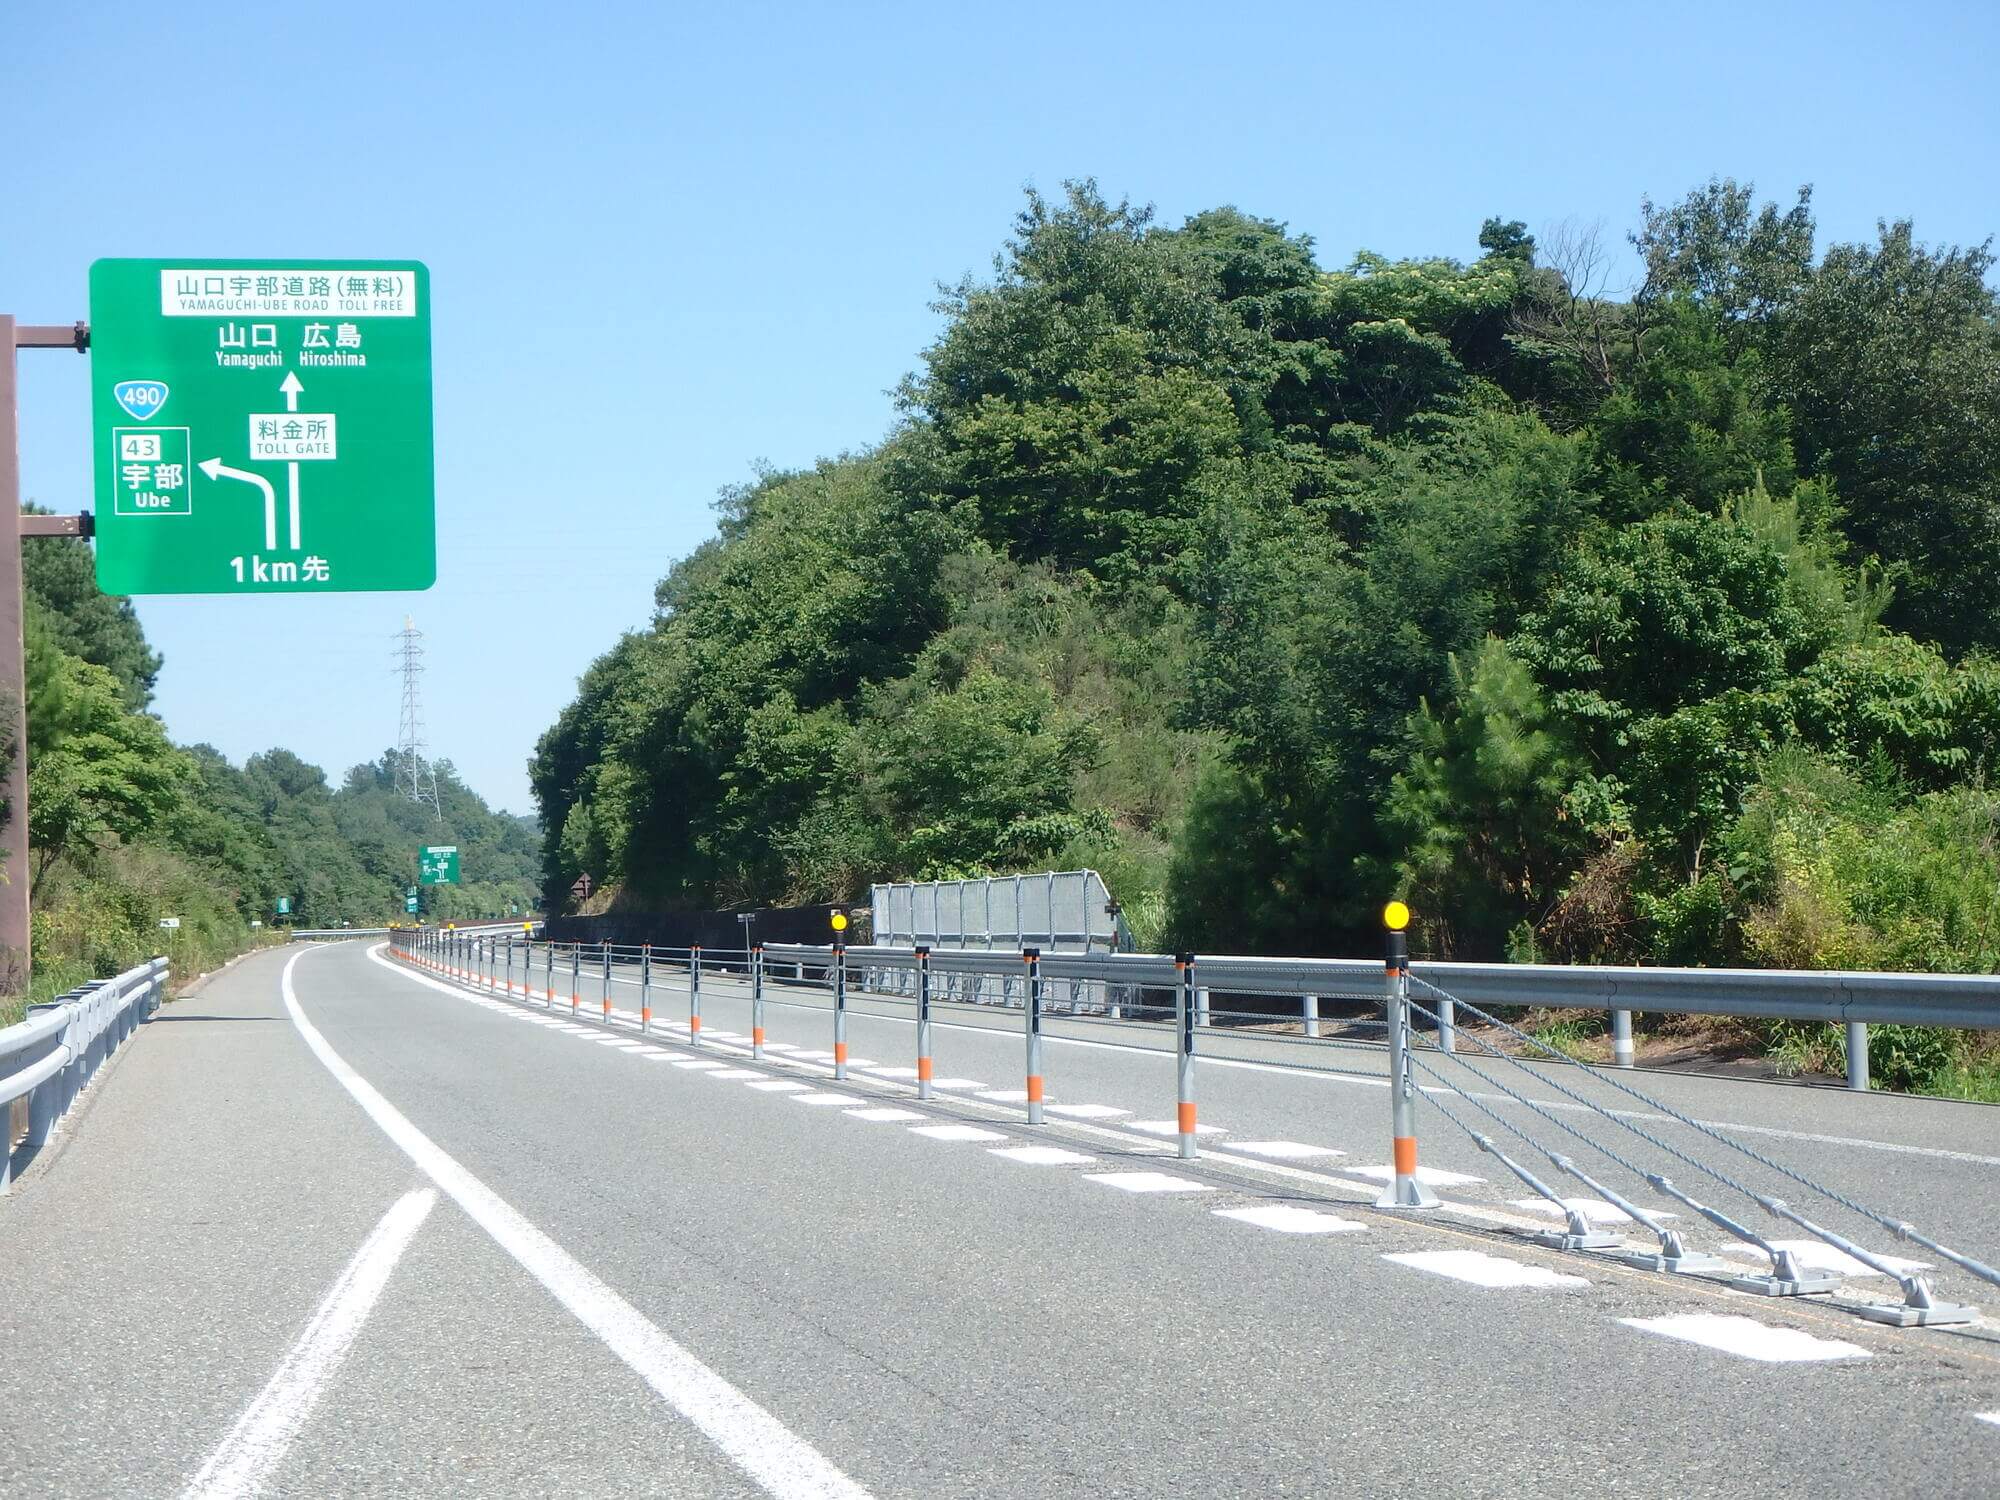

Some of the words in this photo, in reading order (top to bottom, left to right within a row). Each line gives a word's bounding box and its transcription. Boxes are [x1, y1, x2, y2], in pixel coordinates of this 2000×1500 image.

[180, 299, 288, 311] YAMAGUCHI-UBE
[294, 299, 329, 311] ROAD
[339, 299, 368, 311] TOLL
[374, 299, 403, 311] FREE
[219, 322, 277, 348] 山口
[302, 322, 362, 348] 広島
[215, 350, 282, 370] Yamaguchi
[299, 350, 366, 367] Hiroshima
[123, 387, 160, 406] 490
[258, 419, 328, 441] 料金所
[126, 439, 155, 456] 43
[256, 442, 289, 455] TOLL
[295, 442, 330, 455] GATE
[122, 463, 184, 490] 宇部
[135, 491, 171, 508] Ube
